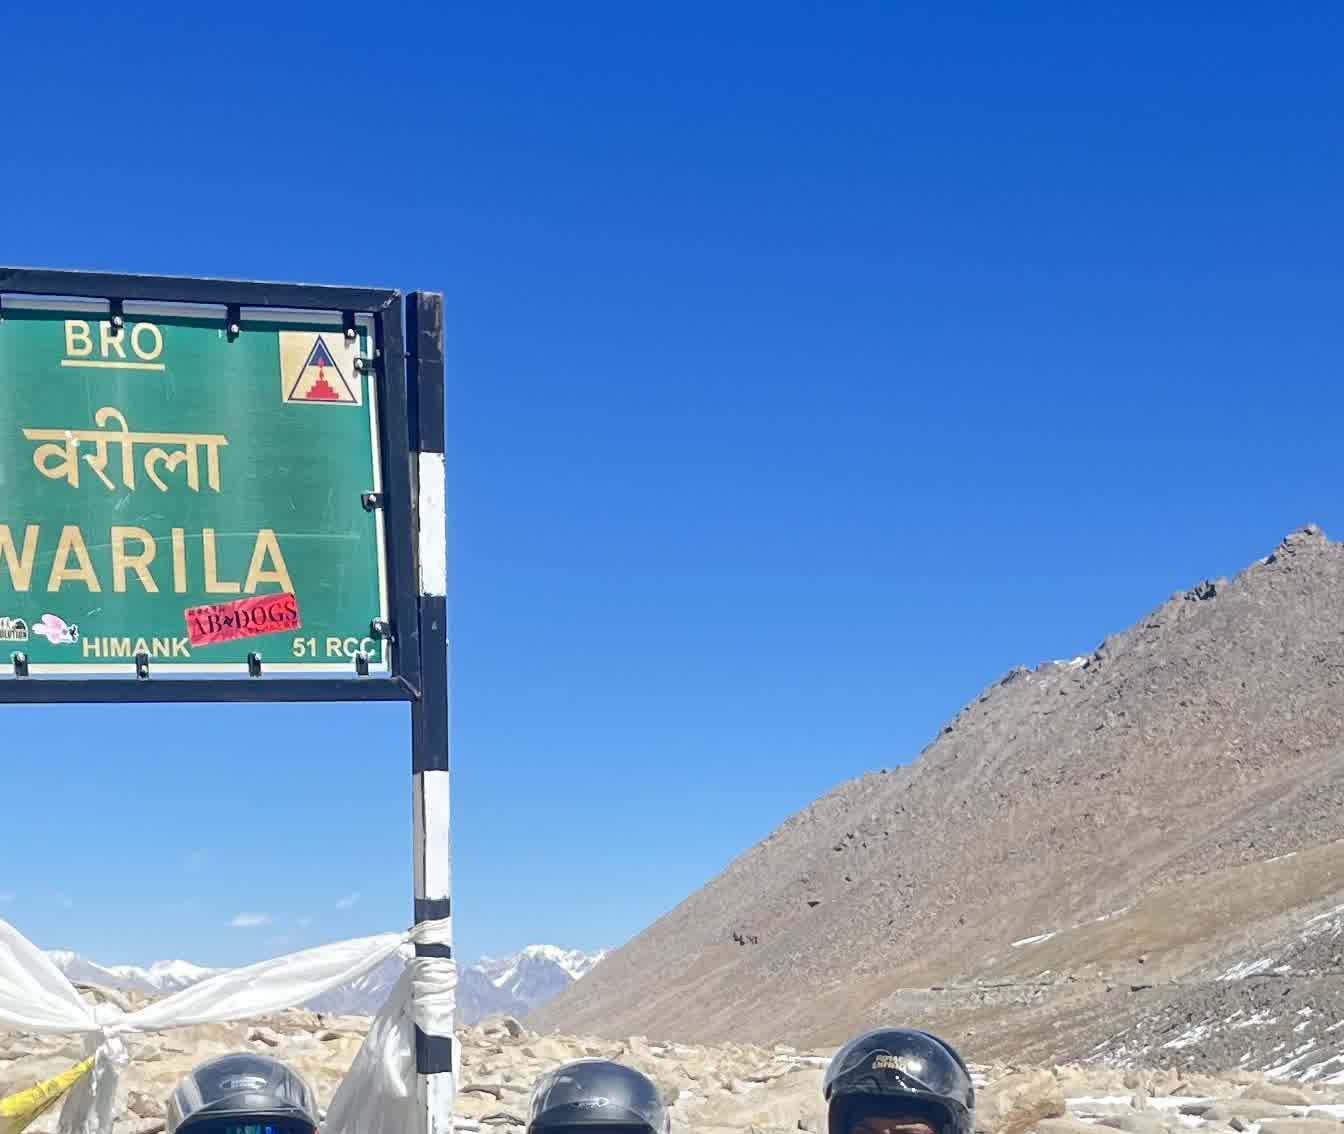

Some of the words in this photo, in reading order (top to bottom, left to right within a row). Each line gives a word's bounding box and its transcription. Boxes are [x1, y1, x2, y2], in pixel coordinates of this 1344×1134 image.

[64, 319, 164, 361] BRO
[22, 406, 229, 493] वरीला
[82, 637, 192, 658] HIMANK
[292, 637, 317, 657] 51
[326, 636, 376, 659] RCC
